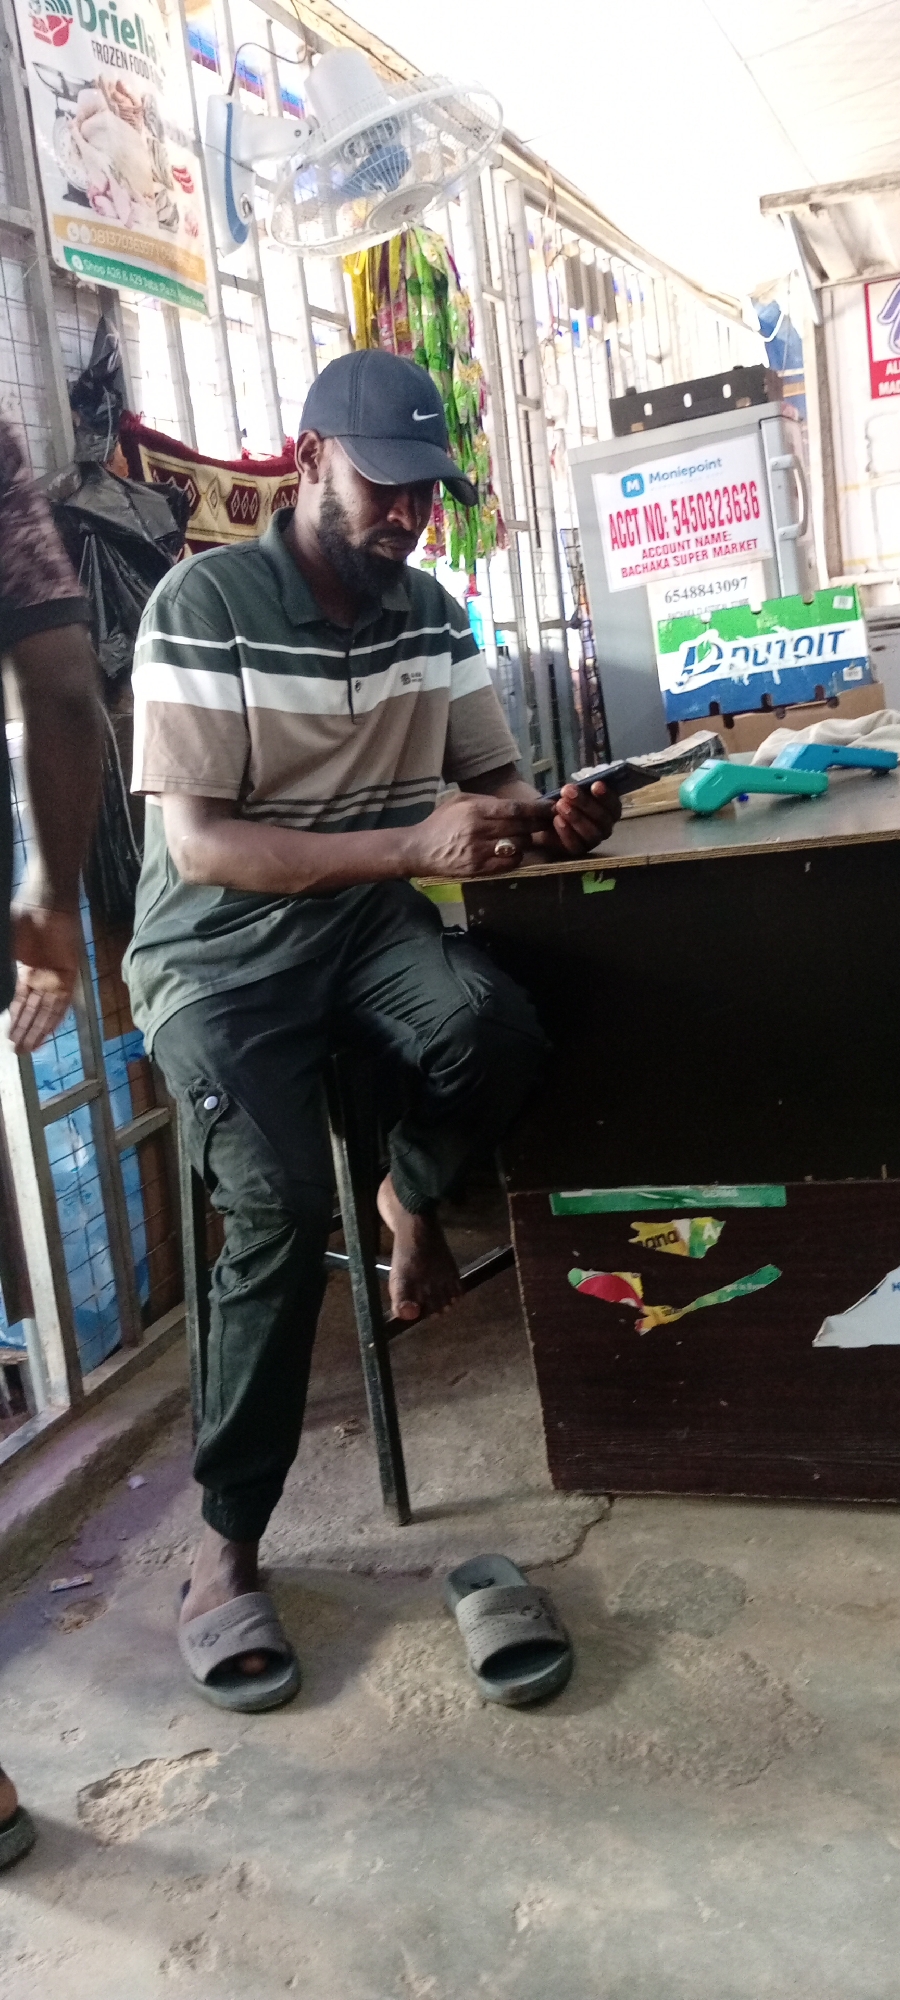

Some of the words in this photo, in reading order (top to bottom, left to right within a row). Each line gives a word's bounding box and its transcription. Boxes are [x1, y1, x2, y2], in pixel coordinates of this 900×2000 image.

[91, 40, 128, 70] FROZEN
[129, 54, 150, 80] FOOD
[885, 360, 900, 376] AL
[649, 457, 722, 484] Moniepoint
[609, 508, 641, 551] ACCT
[643, 502, 670, 543] NO:
[671, 480, 760, 536] 5450323636
[621, 558, 670, 578] BACHAKA
[673, 549, 709, 567] SUPER
[712, 538, 758, 558] MARKET
[642, 539, 691, 560] ACCOUNT
[695, 531, 732, 548] NAME:
[664, 576, 749, 603] 6548843097
